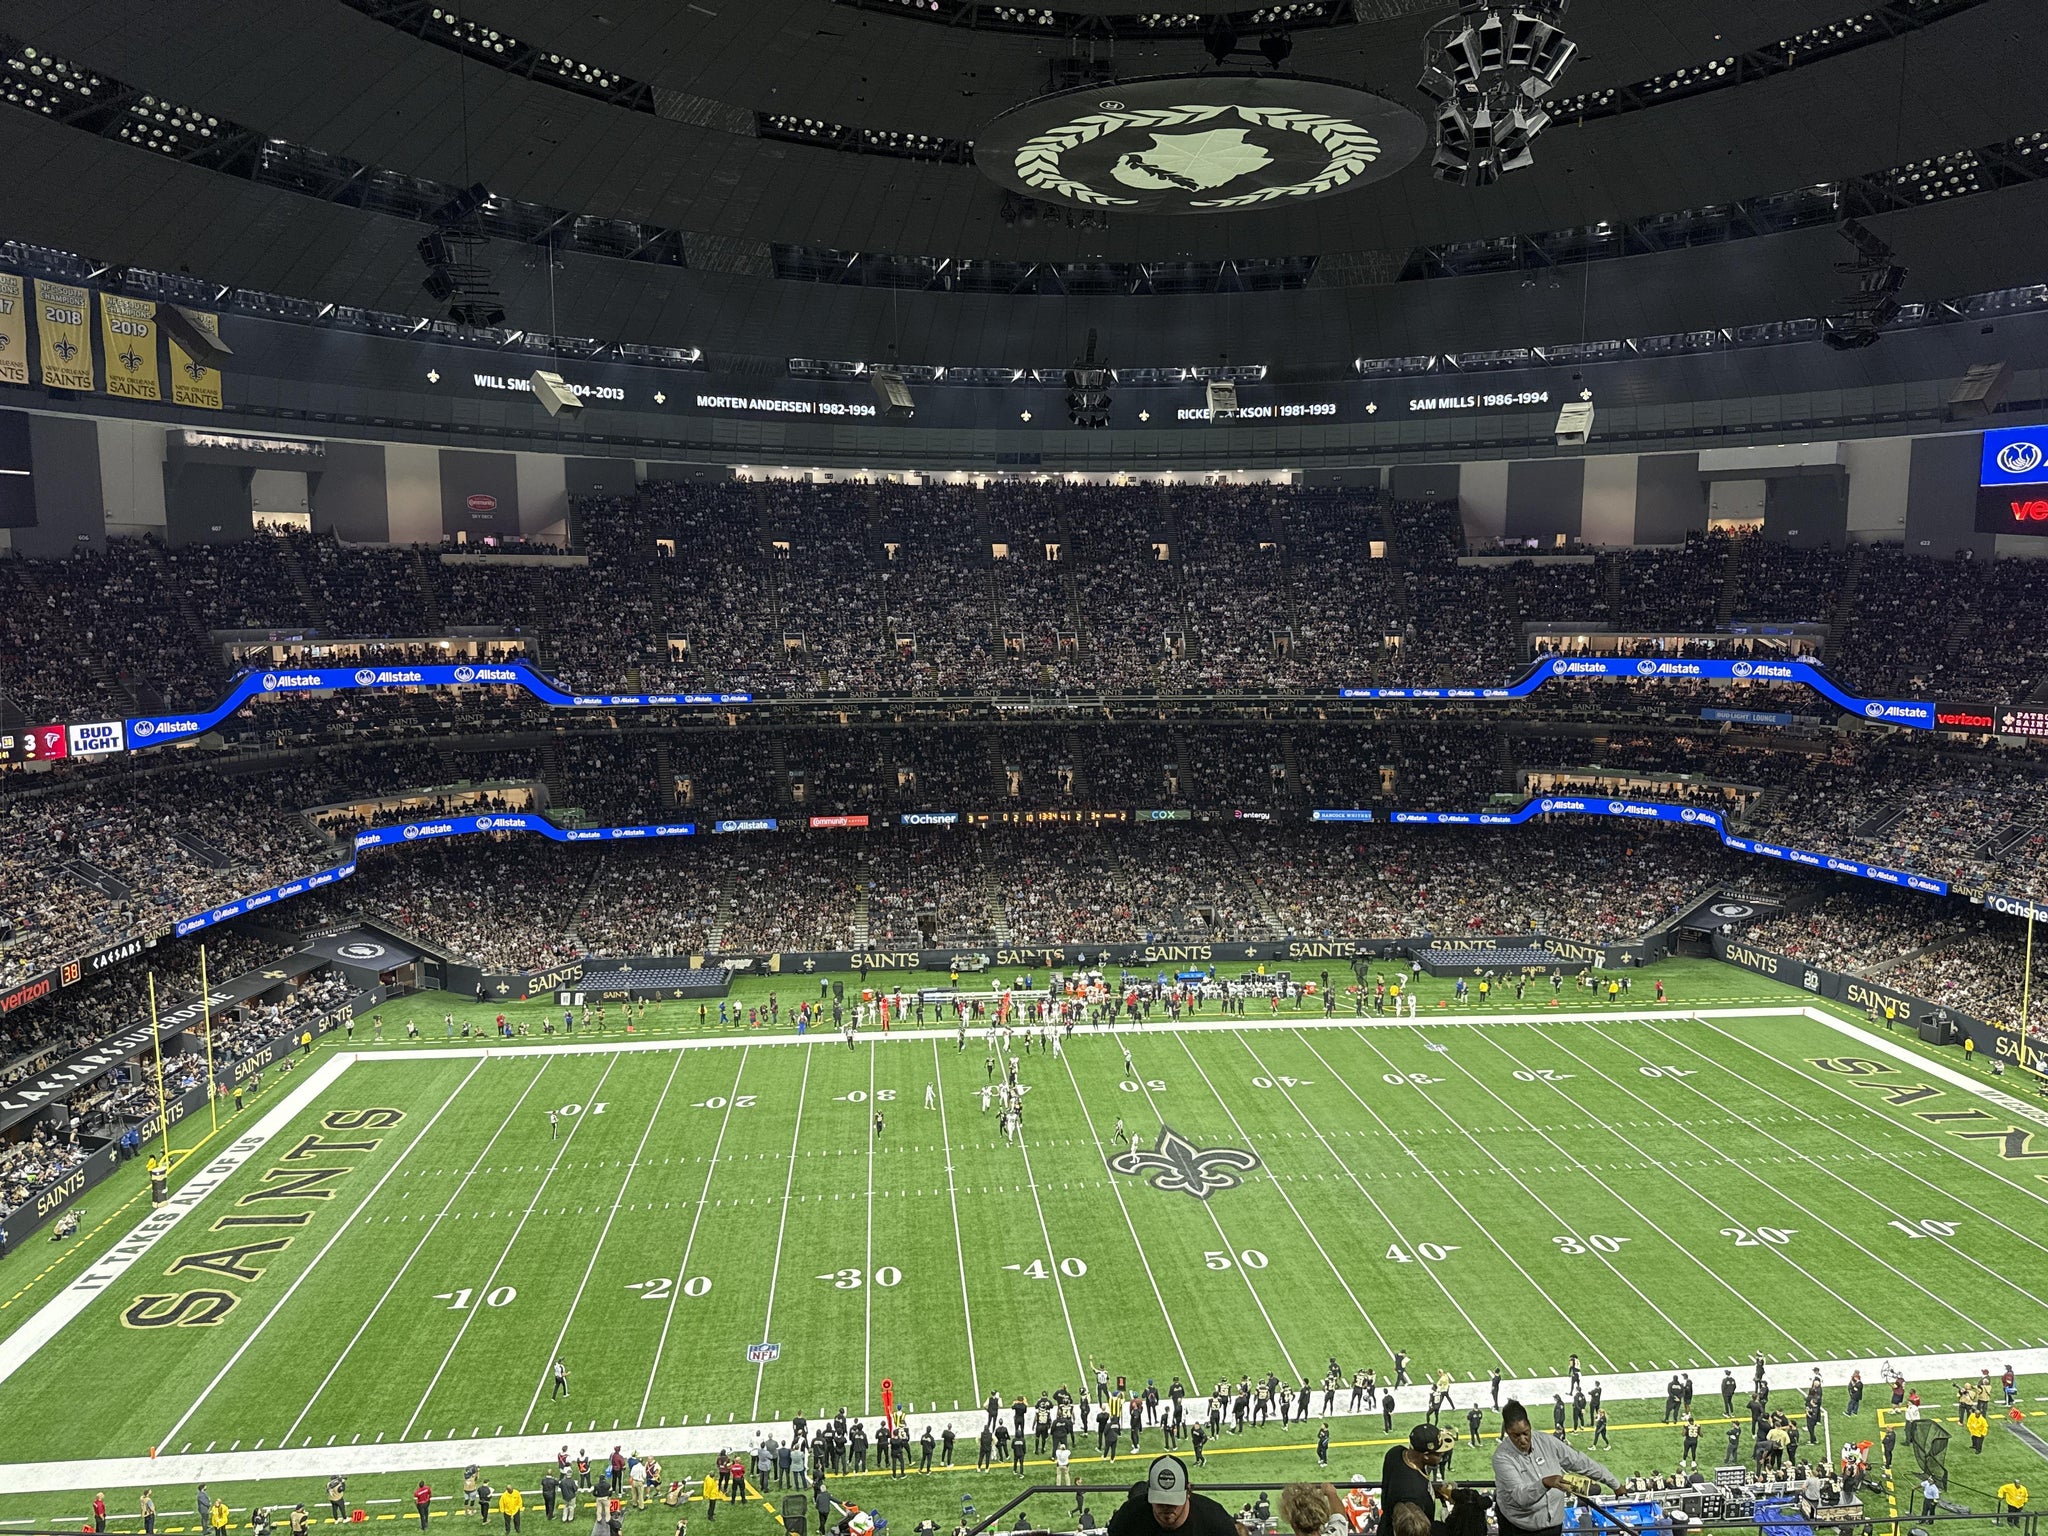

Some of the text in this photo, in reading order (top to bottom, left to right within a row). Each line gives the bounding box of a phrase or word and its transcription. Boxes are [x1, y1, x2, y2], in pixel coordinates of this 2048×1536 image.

[46, 307, 82, 325] 2018
[111, 319, 148, 338] 2019
[45, 371, 91, 389] SAINTS
[474, 374, 506, 389] WILL
[109, 381, 156, 398] SAINTS
[175, 391, 219, 407] SAINTS
[696, 395, 876, 416] MORTEN ANDERSEN 1982-1994
[1409, 391, 1548, 411] SAM MILLS 1986-1994
[1279, 403, 1336, 418] 1981-1993
[475, 669, 516, 680] Allstate
[1567, 661, 1606, 673] Allstate
[1657, 663, 1700, 674] Allstate
[1752, 665, 1792, 677] Allstate
[276, 674, 321, 687] Allstate
[376, 671, 422, 683] Allstate
[1752, 714, 1776, 723] LOUNGE
[1884, 706, 1927, 718] Allstate
[1937, 712, 1992, 727] verizon
[80, 726, 112, 739] BUD
[155, 721, 198, 734] Allstate
[24, 734, 36, 751] 3
[74, 737, 119, 751] LIGHT
[1553, 801, 1584, 810] Allstate
[1624, 805, 1657, 816] Allstate
[812, 817, 848, 826] Community
[910, 815, 956, 824] Ochsner
[1152, 811, 1175, 819] COX
[1243, 812, 1270, 820] entergy
[419, 825, 452, 836] Allstate
[492, 819, 526, 828] Allstate
[737, 821, 768, 830] Allstate
[1952, 885, 1984, 899] SAINTS
[144, 926, 170, 942] SAINTS
[93, 941, 141, 969] CAESARS
[1145, 945, 1212, 962] SAINTS
[1289, 942, 1357, 958] SAINTS
[1544, 940, 1606, 964] SAINTS
[851, 952, 920, 969] SAINTS
[1726, 944, 1777, 974] SAINTS
[64, 963, 78, 982] 38
[528, 964, 584, 995] SAINTS
[0, 979, 50, 1012] verizon
[1848, 985, 1910, 1020] SAINTS
[113, 992, 235, 1048] SUPERDOME
[235, 1048, 273, 1082] SAINTS
[38, 1167, 85, 1219] SAINTS
[73, 1136, 265, 1291] IT TAKES ALL OF US
[120, 1108, 406, 1329] SAINTS
[1720, 1226, 1790, 1247] 20
[1889, 1218, 1956, 1239] 10
[1385, 1241, 1449, 1263] 40
[1552, 1234, 1622, 1255] 30
[1203, 1248, 1271, 1271] 50
[1023, 1257, 1088, 1280] 40
[833, 1266, 902, 1289] 30
[636, 1276, 713, 1300] 20
[446, 1286, 518, 1310] 10
[752, 1351, 777, 1360] NFL
[610, 1501, 619, 1511] 20
[353, 1513, 362, 1521] 10
